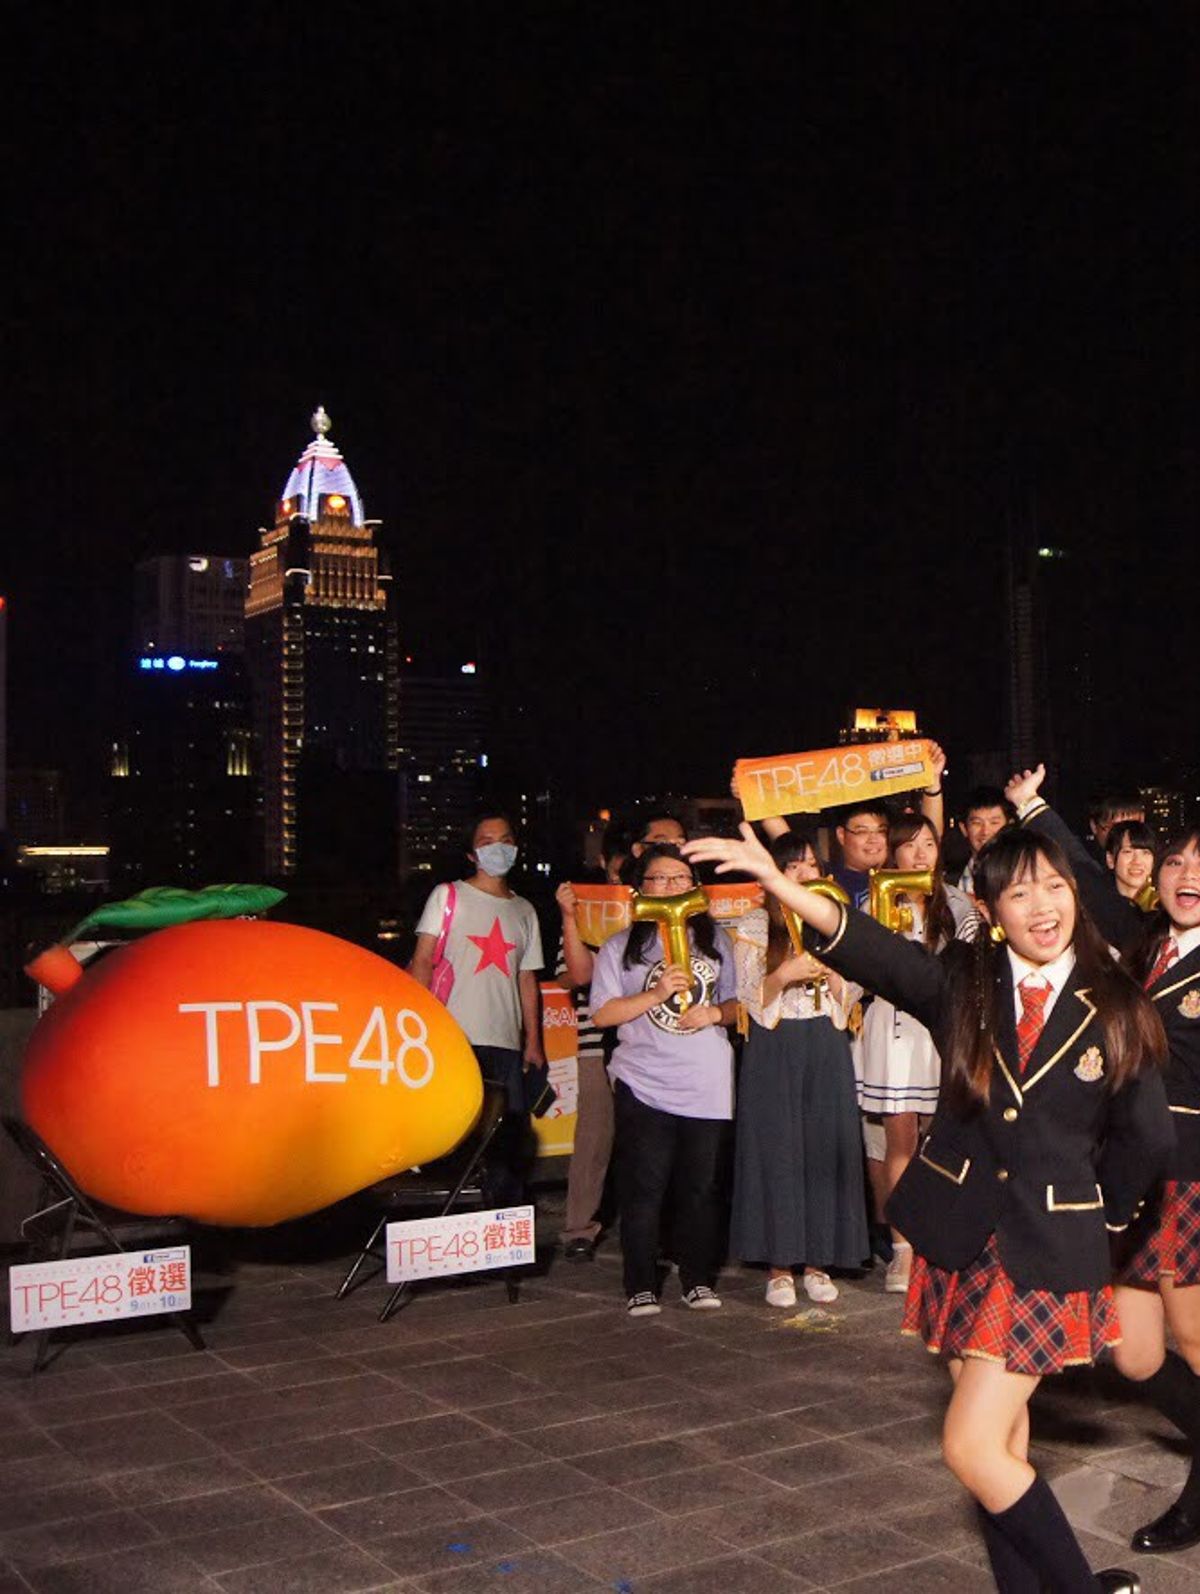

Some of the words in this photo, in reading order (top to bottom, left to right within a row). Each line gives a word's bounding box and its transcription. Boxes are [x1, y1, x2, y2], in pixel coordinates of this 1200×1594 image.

[744, 752, 866, 802] TPE48
[178, 1000, 435, 1090] TPE48
[390, 1230, 479, 1267] TPE48
[14, 1274, 123, 1315] TPE48
[127, 1262, 187, 1298] 徵選
